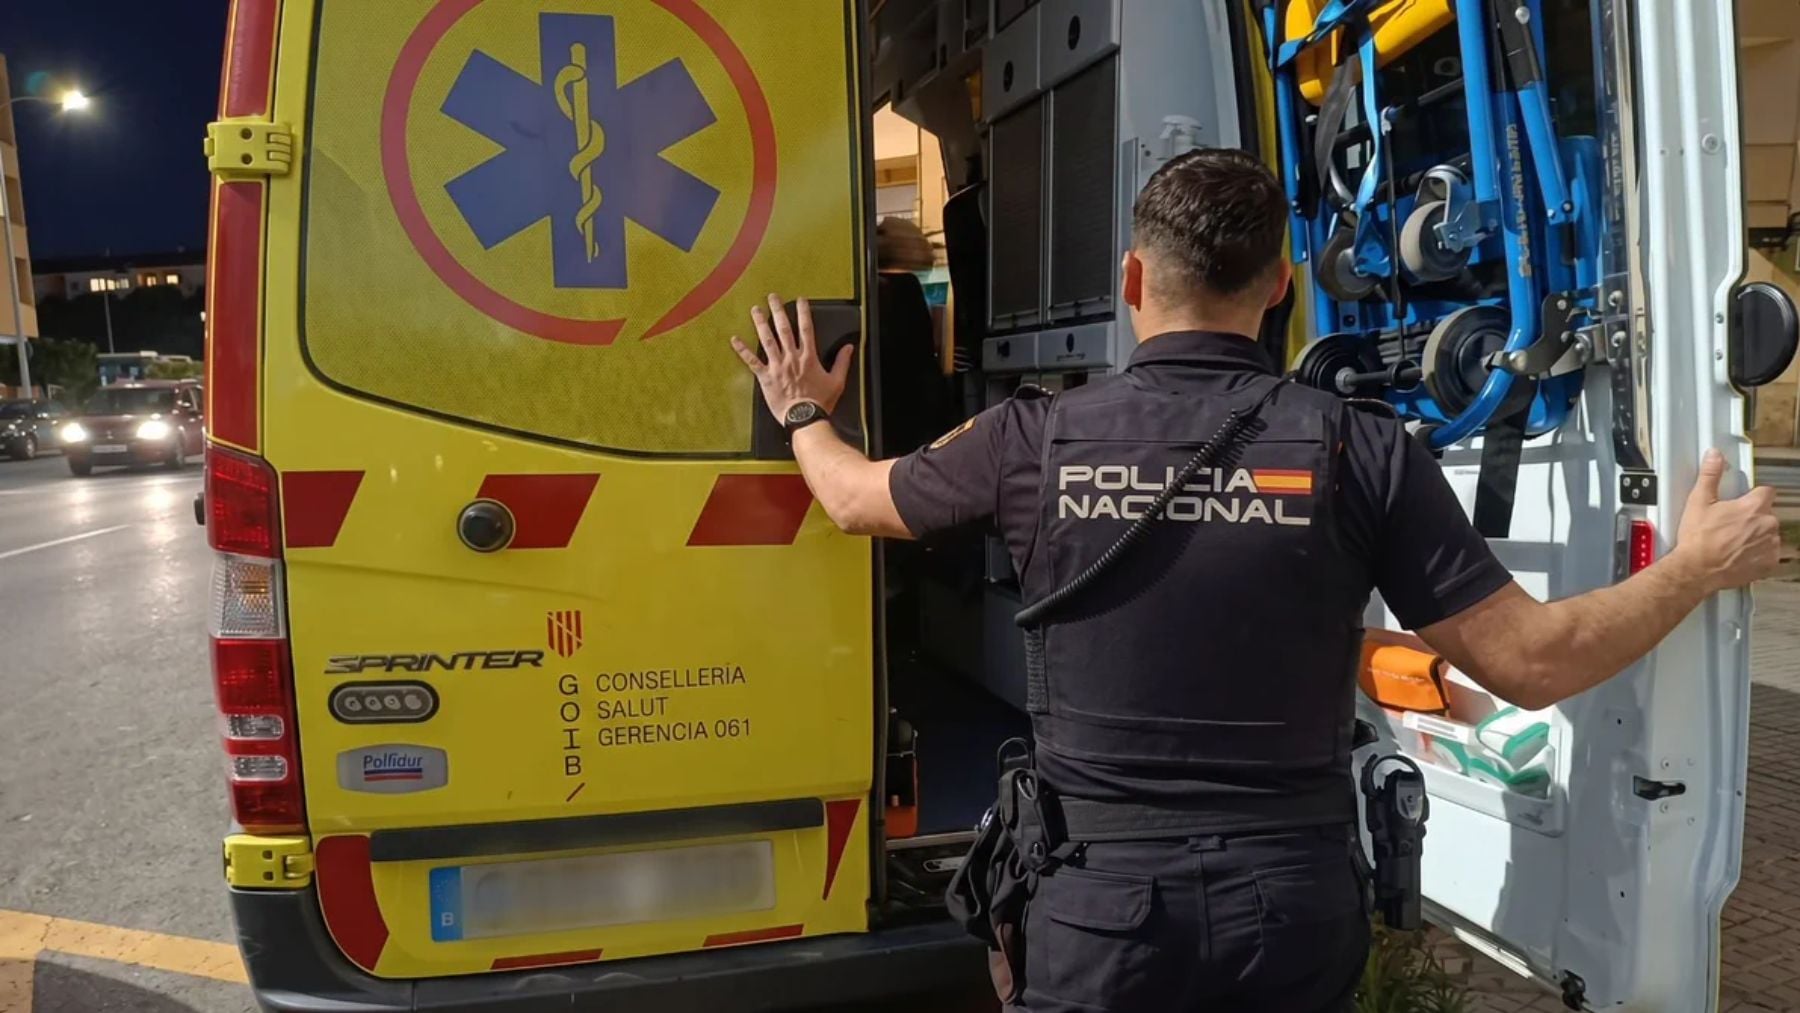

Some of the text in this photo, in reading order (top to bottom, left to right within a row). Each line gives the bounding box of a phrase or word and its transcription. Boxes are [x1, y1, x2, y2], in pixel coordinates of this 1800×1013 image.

[1059, 495, 1311, 525] NACONAL
[324, 650, 544, 674] SPRINTER
[597, 696, 669, 719] SALUT
[598, 718, 751, 747] GERENCIA 061
[363, 752, 423, 769] Polfidur
